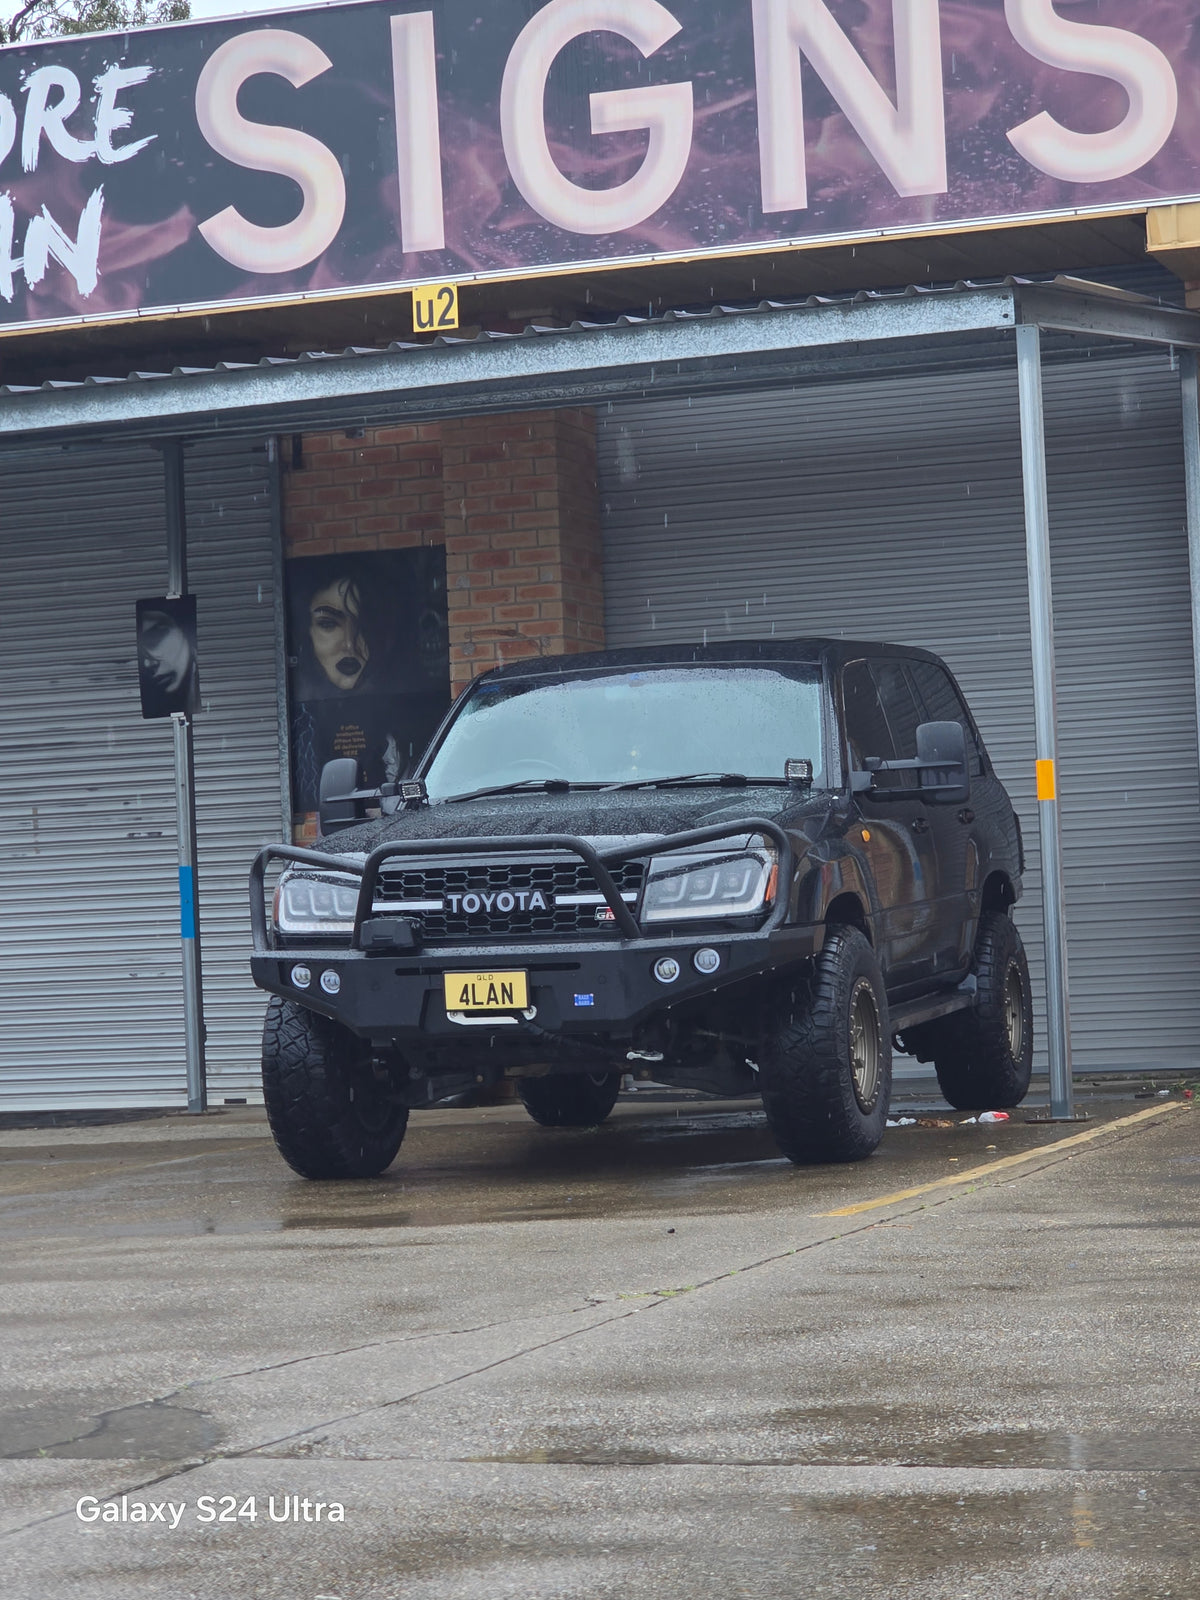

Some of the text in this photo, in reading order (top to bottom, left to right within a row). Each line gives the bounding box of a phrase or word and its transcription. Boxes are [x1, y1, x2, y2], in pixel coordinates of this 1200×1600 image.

[195, 0, 1178, 274] SIGNS
[415, 287, 457, 329] u2
[447, 891, 546, 914] TOYOTA
[459, 982, 514, 1006] 4LAN
